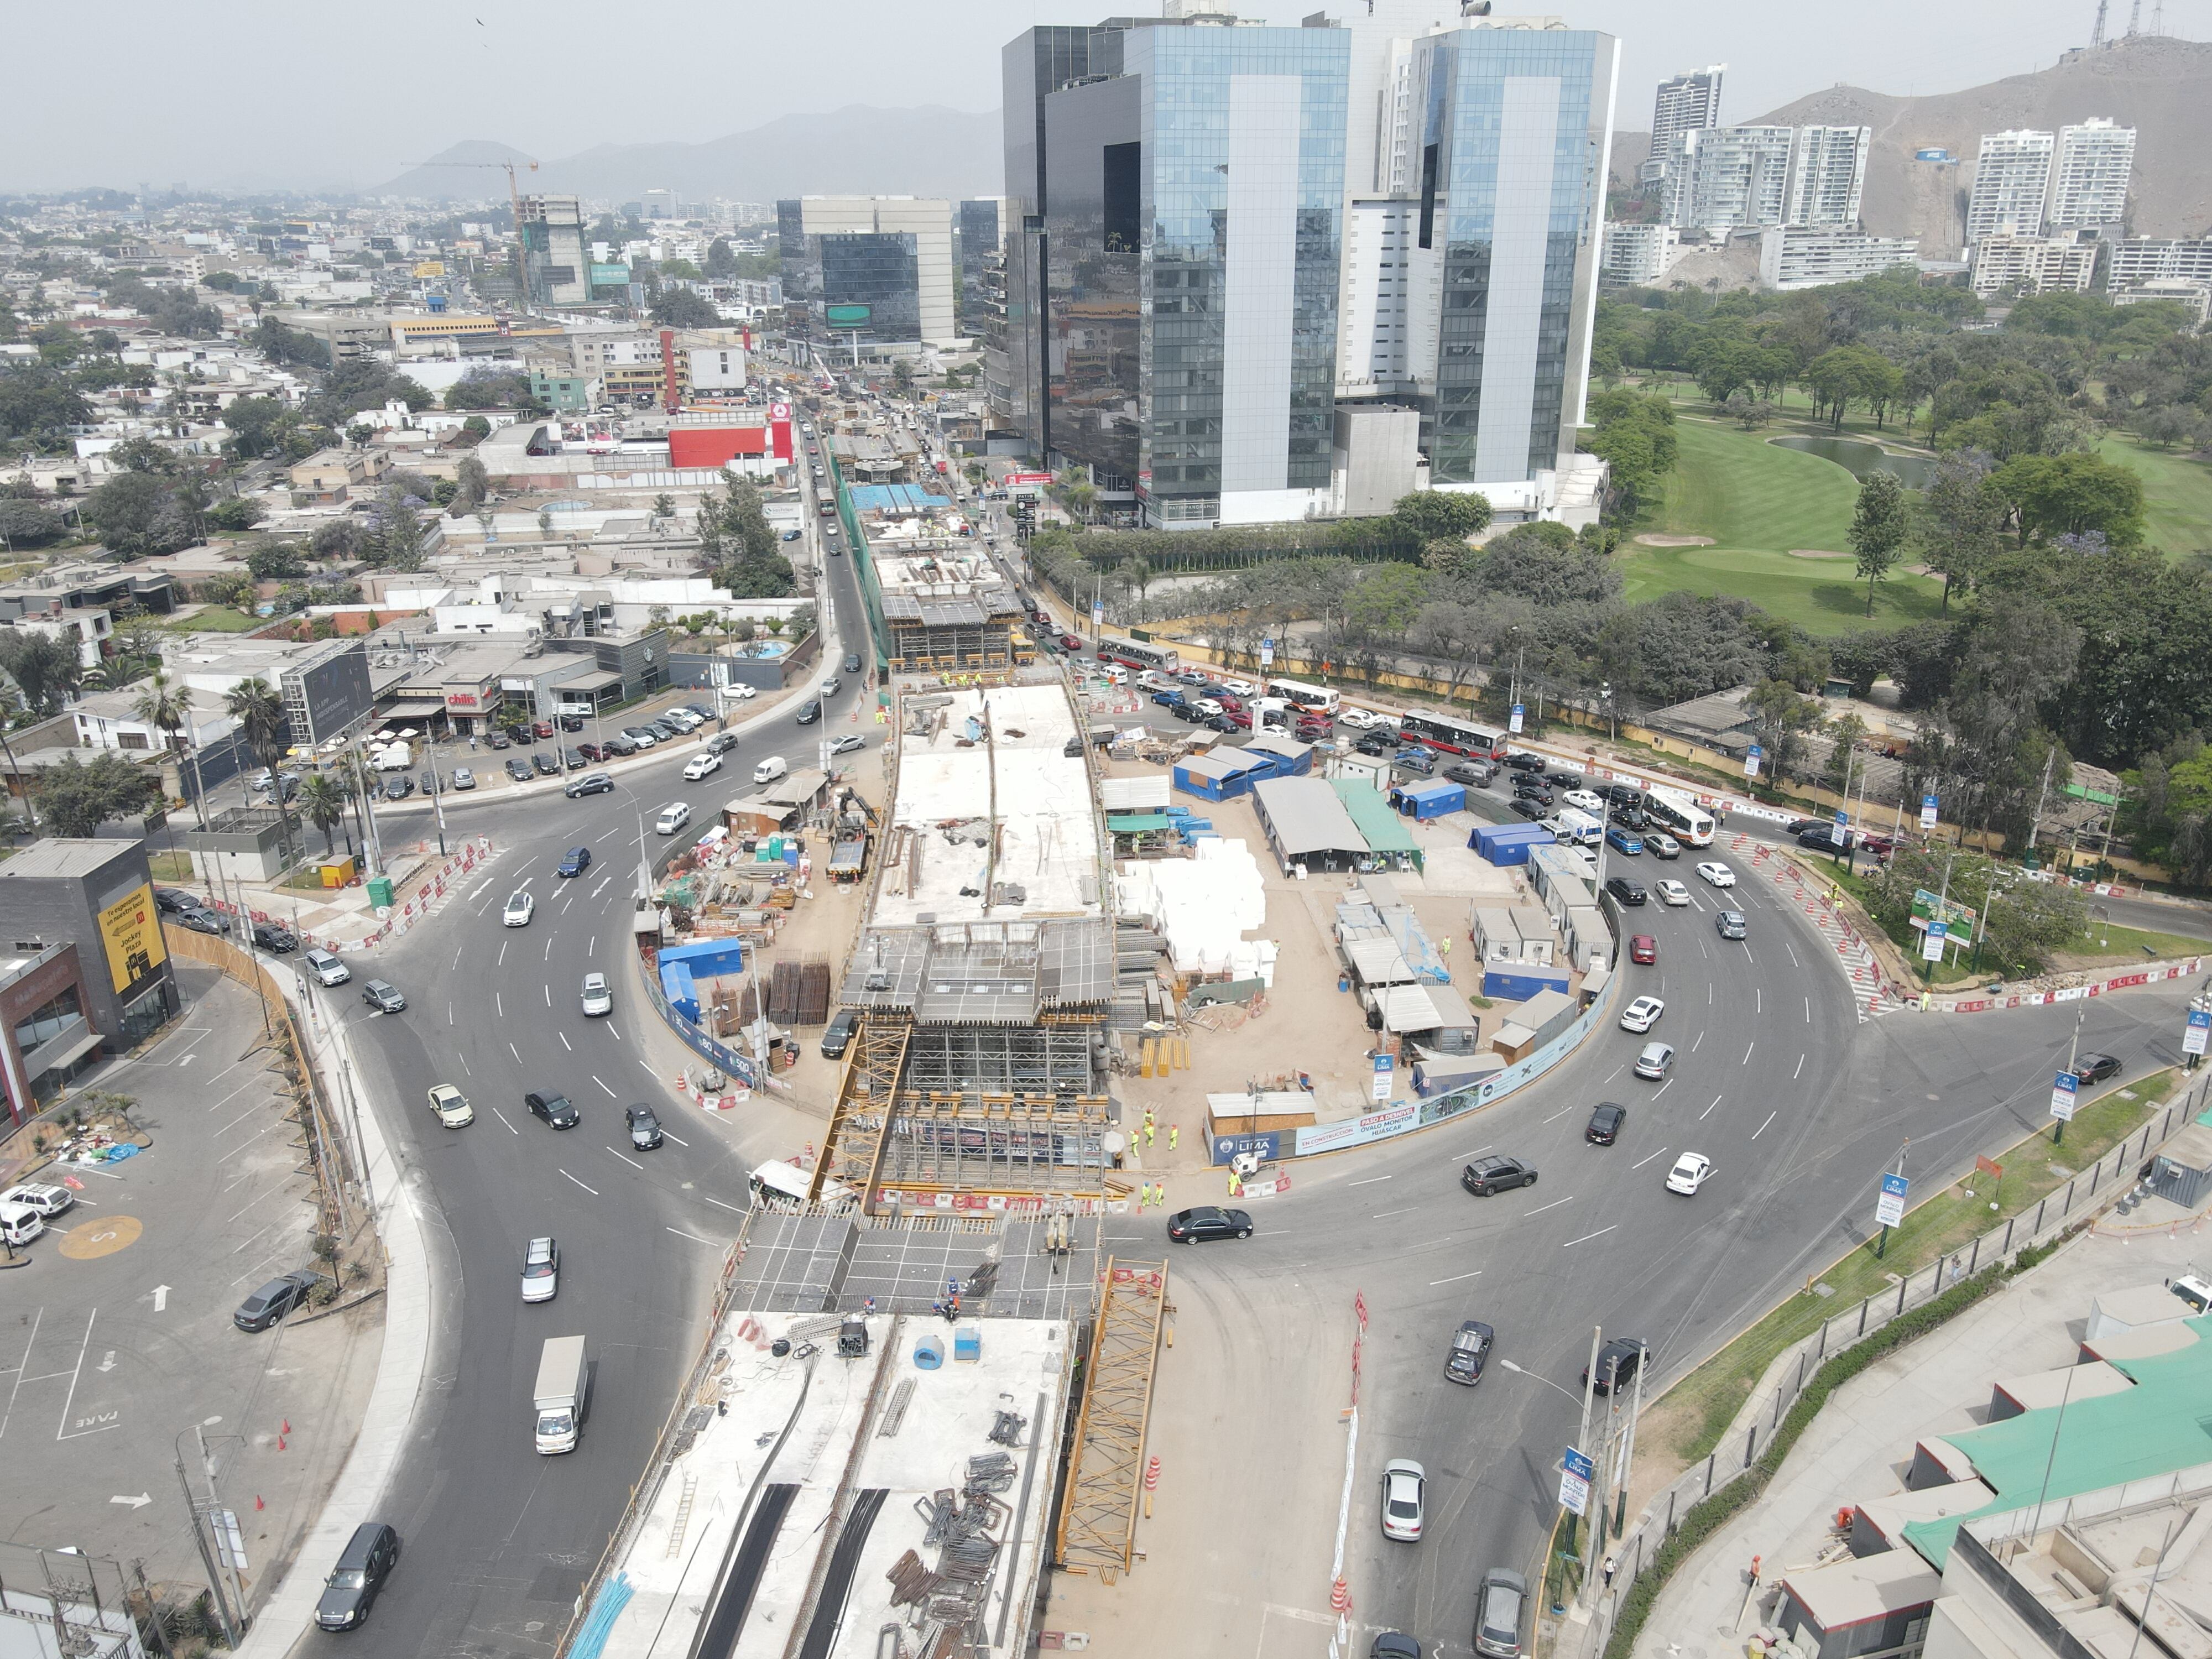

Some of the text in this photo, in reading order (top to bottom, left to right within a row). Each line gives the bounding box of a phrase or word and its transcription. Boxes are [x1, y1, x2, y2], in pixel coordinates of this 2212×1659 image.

[113, 907, 132, 921] nuestro
[133, 898, 144, 909] local
[114, 893, 142, 914] esperamos
[121, 930, 141, 947] Jockey
[126, 940, 142, 954] Plaza
[703, 1039, 712, 1052] 80
[736, 1058, 749, 1073] 500
[1361, 1118, 1378, 1126] PASO
[1385, 1108, 1414, 1119] DESNIVEL
[1384, 1114, 1412, 1126] MONITOR
[1239, 1141, 1269, 1151] LIMA
[1569, 1463, 1586, 1477] LIMA
